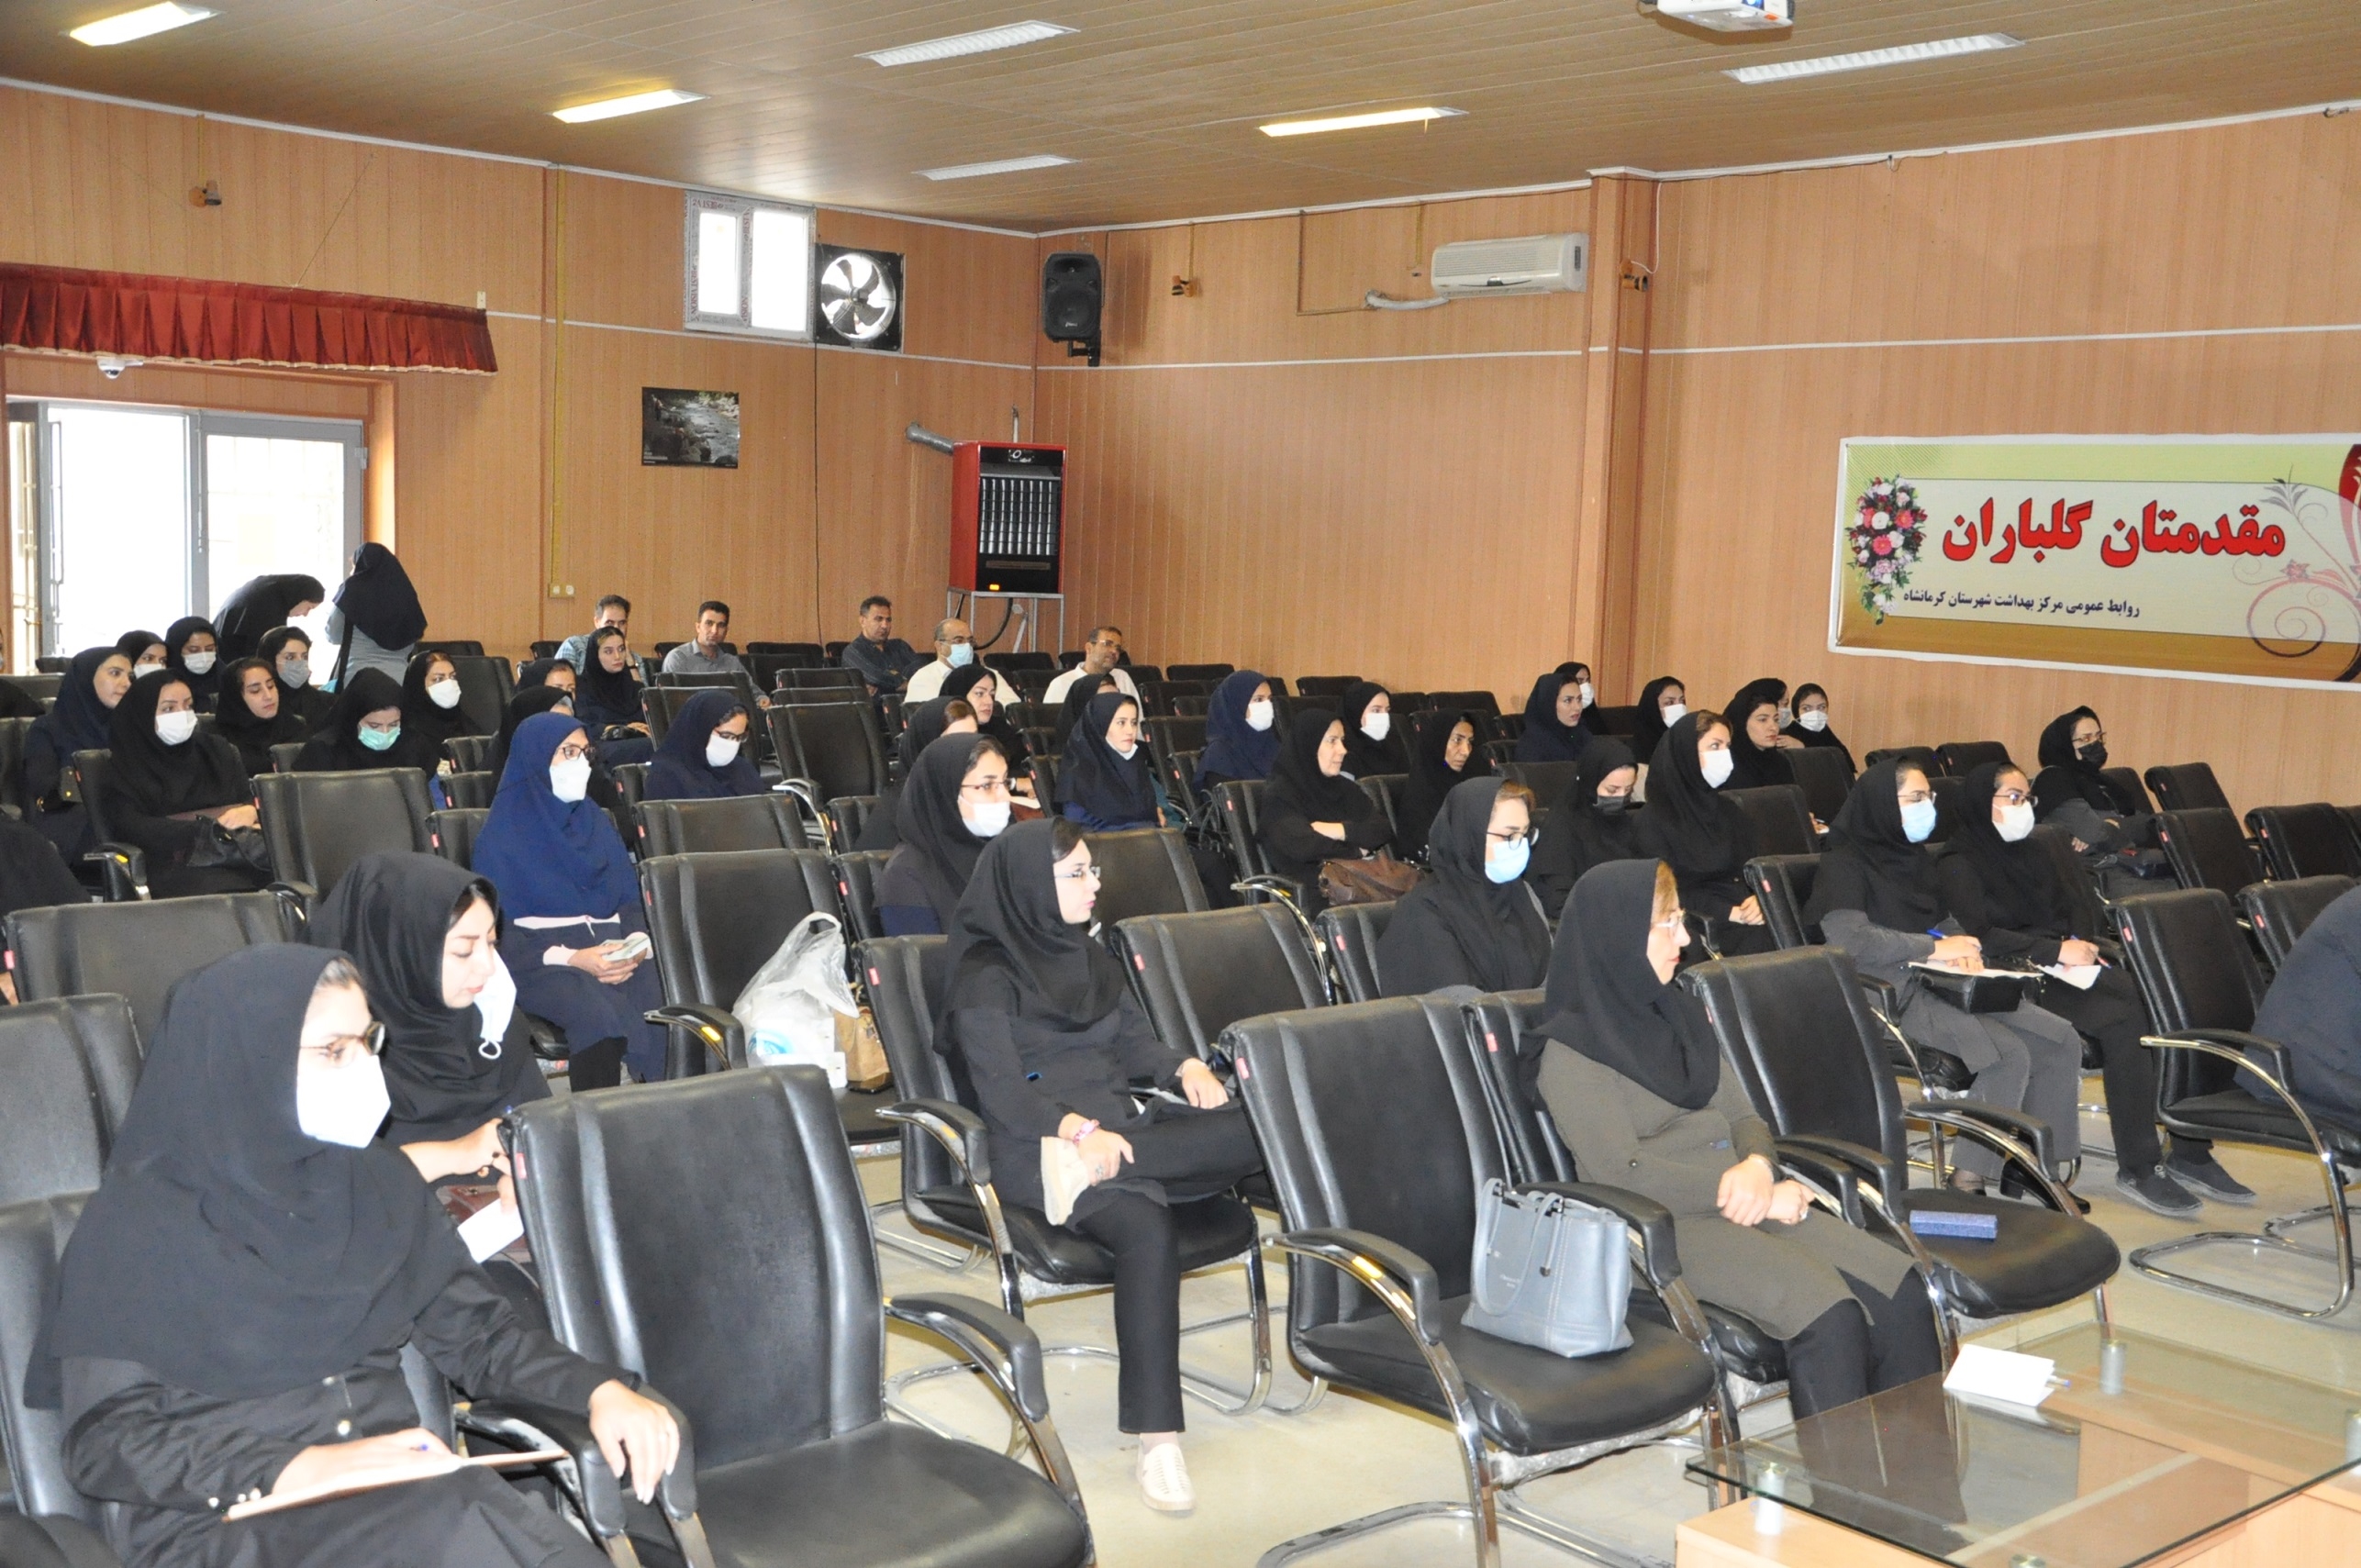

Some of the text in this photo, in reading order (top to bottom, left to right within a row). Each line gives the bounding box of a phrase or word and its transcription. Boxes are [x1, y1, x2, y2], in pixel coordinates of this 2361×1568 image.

[1943, 497, 2286, 567] مقدمتان گلباران
[1903, 589, 2140, 617] روابط عمومی مرکز بهداشت شهرستان کرمانشاه
